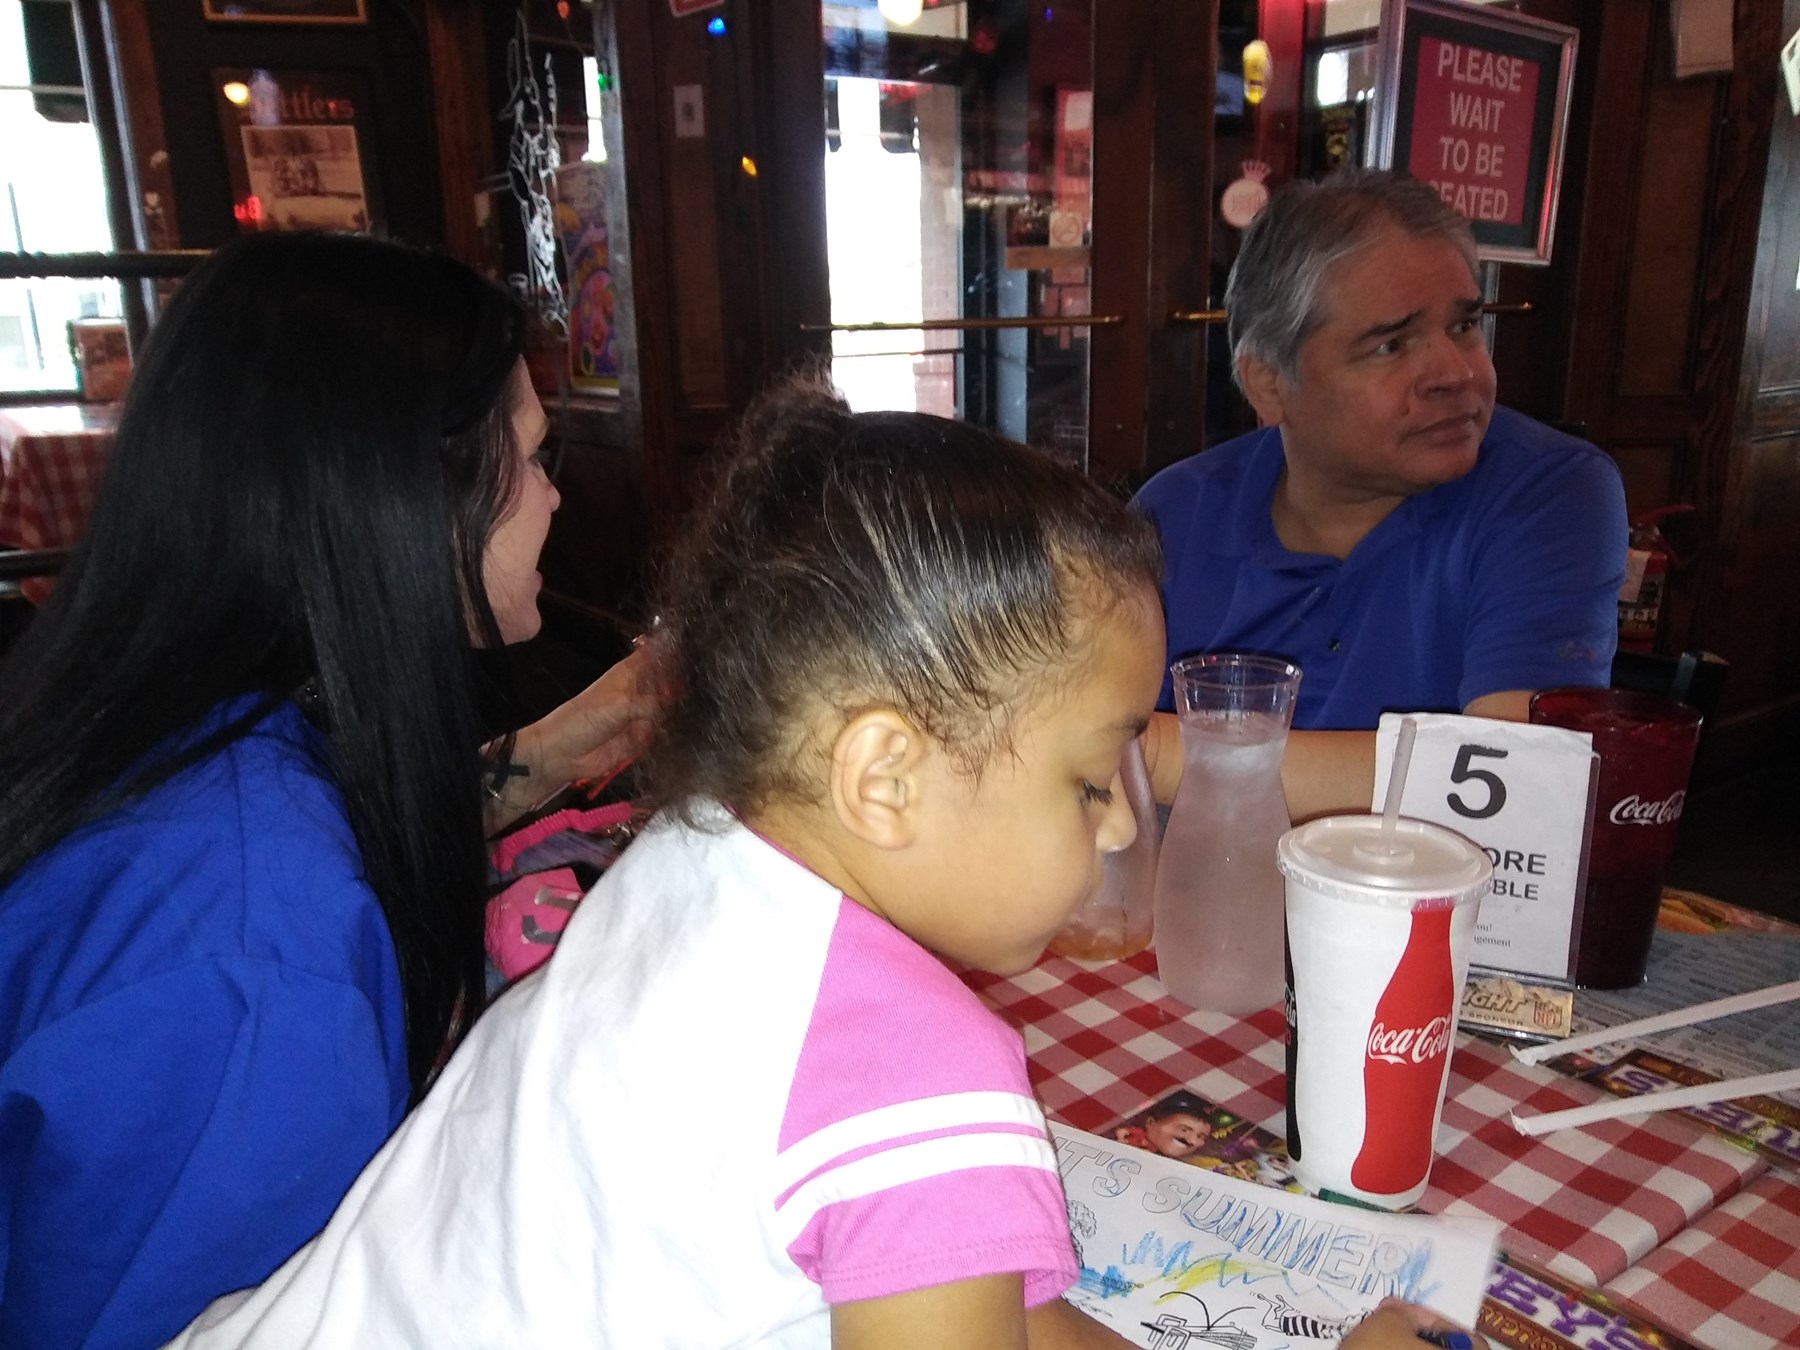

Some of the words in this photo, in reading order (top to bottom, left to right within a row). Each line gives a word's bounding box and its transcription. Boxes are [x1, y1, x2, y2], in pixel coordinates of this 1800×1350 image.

[1437, 42, 1524, 92] PLEASE
[1449, 91, 1505, 133] WAIT
[1440, 136, 1469, 174] TO
[1475, 143, 1505, 178] BE
[1446, 743, 1509, 819] 5
[1482, 846, 1548, 876] ORE
[1492, 878, 1540, 901] BLE
[1476, 922, 1493, 933] ou!
[1141, 1176, 1410, 1297] SUMMER
